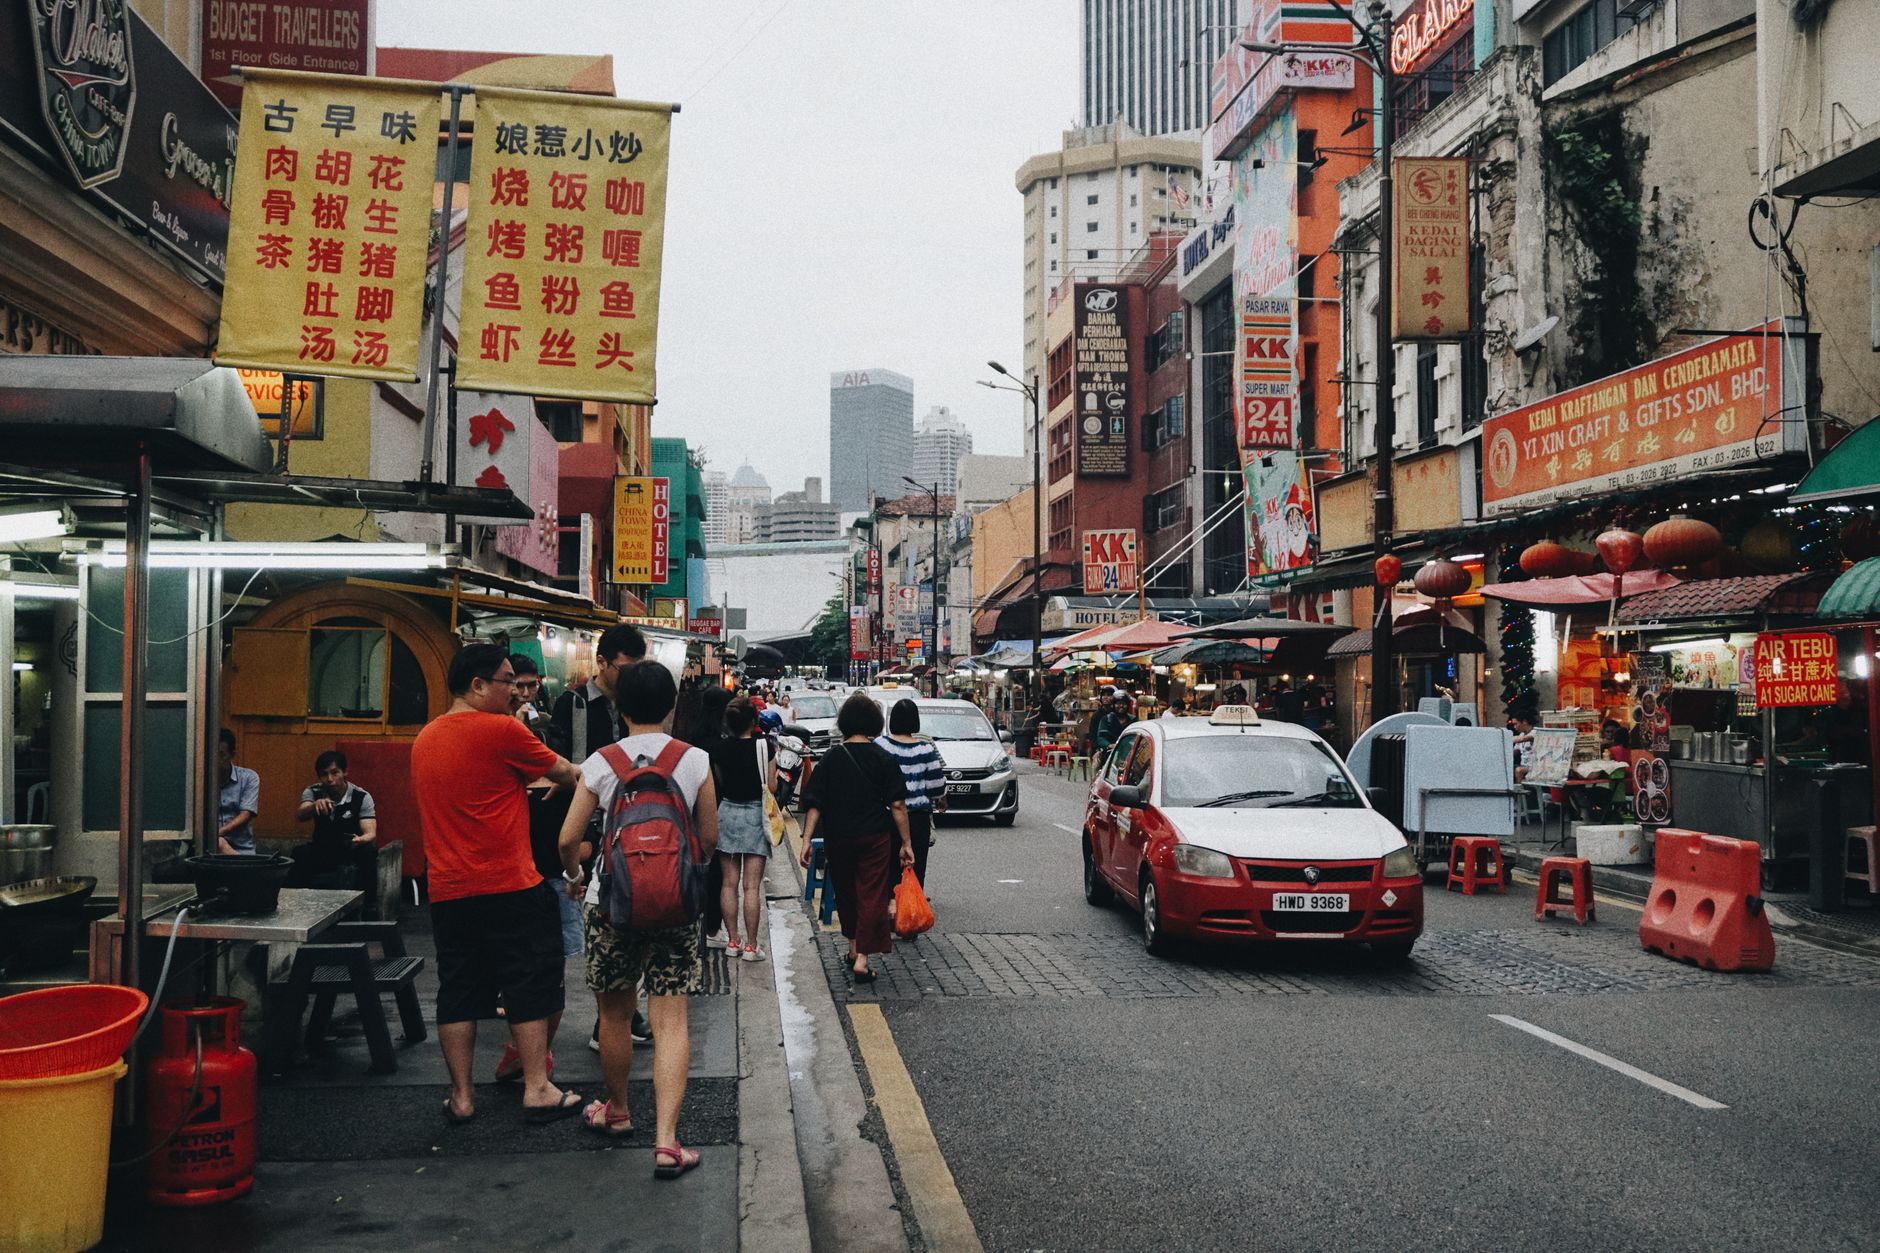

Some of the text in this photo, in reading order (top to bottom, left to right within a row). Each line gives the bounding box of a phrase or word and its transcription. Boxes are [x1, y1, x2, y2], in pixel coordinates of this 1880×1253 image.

[209, 1, 360, 50] BUDGET TRAVELLERS
[231, 49, 262, 64] Floor
[268, 52, 298, 67] (Side
[303, 54, 360, 72] Entrance)
[1306, 59, 1331, 71] KK
[263, 98, 417, 145] 古早味
[494, 120, 644, 165] 娘惹小炒
[255, 144, 299, 269] 肉骨茶
[1403, 235, 1463, 247] DAGING
[1408, 225, 1459, 236] KEDAI
[298, 148, 353, 363] 胡椒猪肚汤
[351, 154, 406, 367] 花生猪脚汤
[1183, 228, 1210, 277] HOTEL
[1409, 247, 1458, 258] SALAI
[479, 166, 531, 364] 烧烤鱼虾
[537, 170, 588, 368] 饭粥粉丝
[594, 176, 647, 373] 咖喱鱼头
[1087, 312, 1117, 325] BARANG
[1245, 300, 1290, 315] PASAR RAYA
[1098, 350, 1126, 362] THONG
[1246, 337, 1290, 359] KK
[842, 371, 871, 387] AIA
[1245, 383, 1290, 395] SUPER MART
[1528, 339, 1757, 433] KEDAI KRAFTANGAN DAN CENDERAMATA
[1247, 399, 1289, 429] 24
[1522, 366, 1771, 461] YI XIN CRAFT & GIFTS SDN. BHD.
[1248, 430, 1289, 445] JAM
[1692, 457, 1708, 470] FAX
[1715, 452, 1724, 461] 03
[1732, 448, 1750, 461] 2026
[1641, 470, 1657, 482] 2026
[618, 506, 648, 517] CHINA
[621, 516, 647, 526] TOWN
[653, 484, 669, 577] HOTEL
[1090, 533, 1128, 563] KK
[870, 550, 879, 594] HOTEL
[1103, 565, 1118, 589] 24
[1119, 563, 1136, 589] JAM
[688, 619, 709, 627] REGGAE
[1075, 612, 1118, 625] HOTEL
[698, 626, 712, 634] CAFE
[1757, 638, 1834, 660] AIR TEBU
[1757, 659, 1836, 683] 纯正甘蔗水
[1760, 684, 1837, 704] A1 SUGAR CANE
[1225, 706, 1248, 714] TEKSI
[956, 784, 972, 793] 9227
[1279, 896, 1344, 910] HWD 9368
[167, 1129, 235, 1148] PETRON
